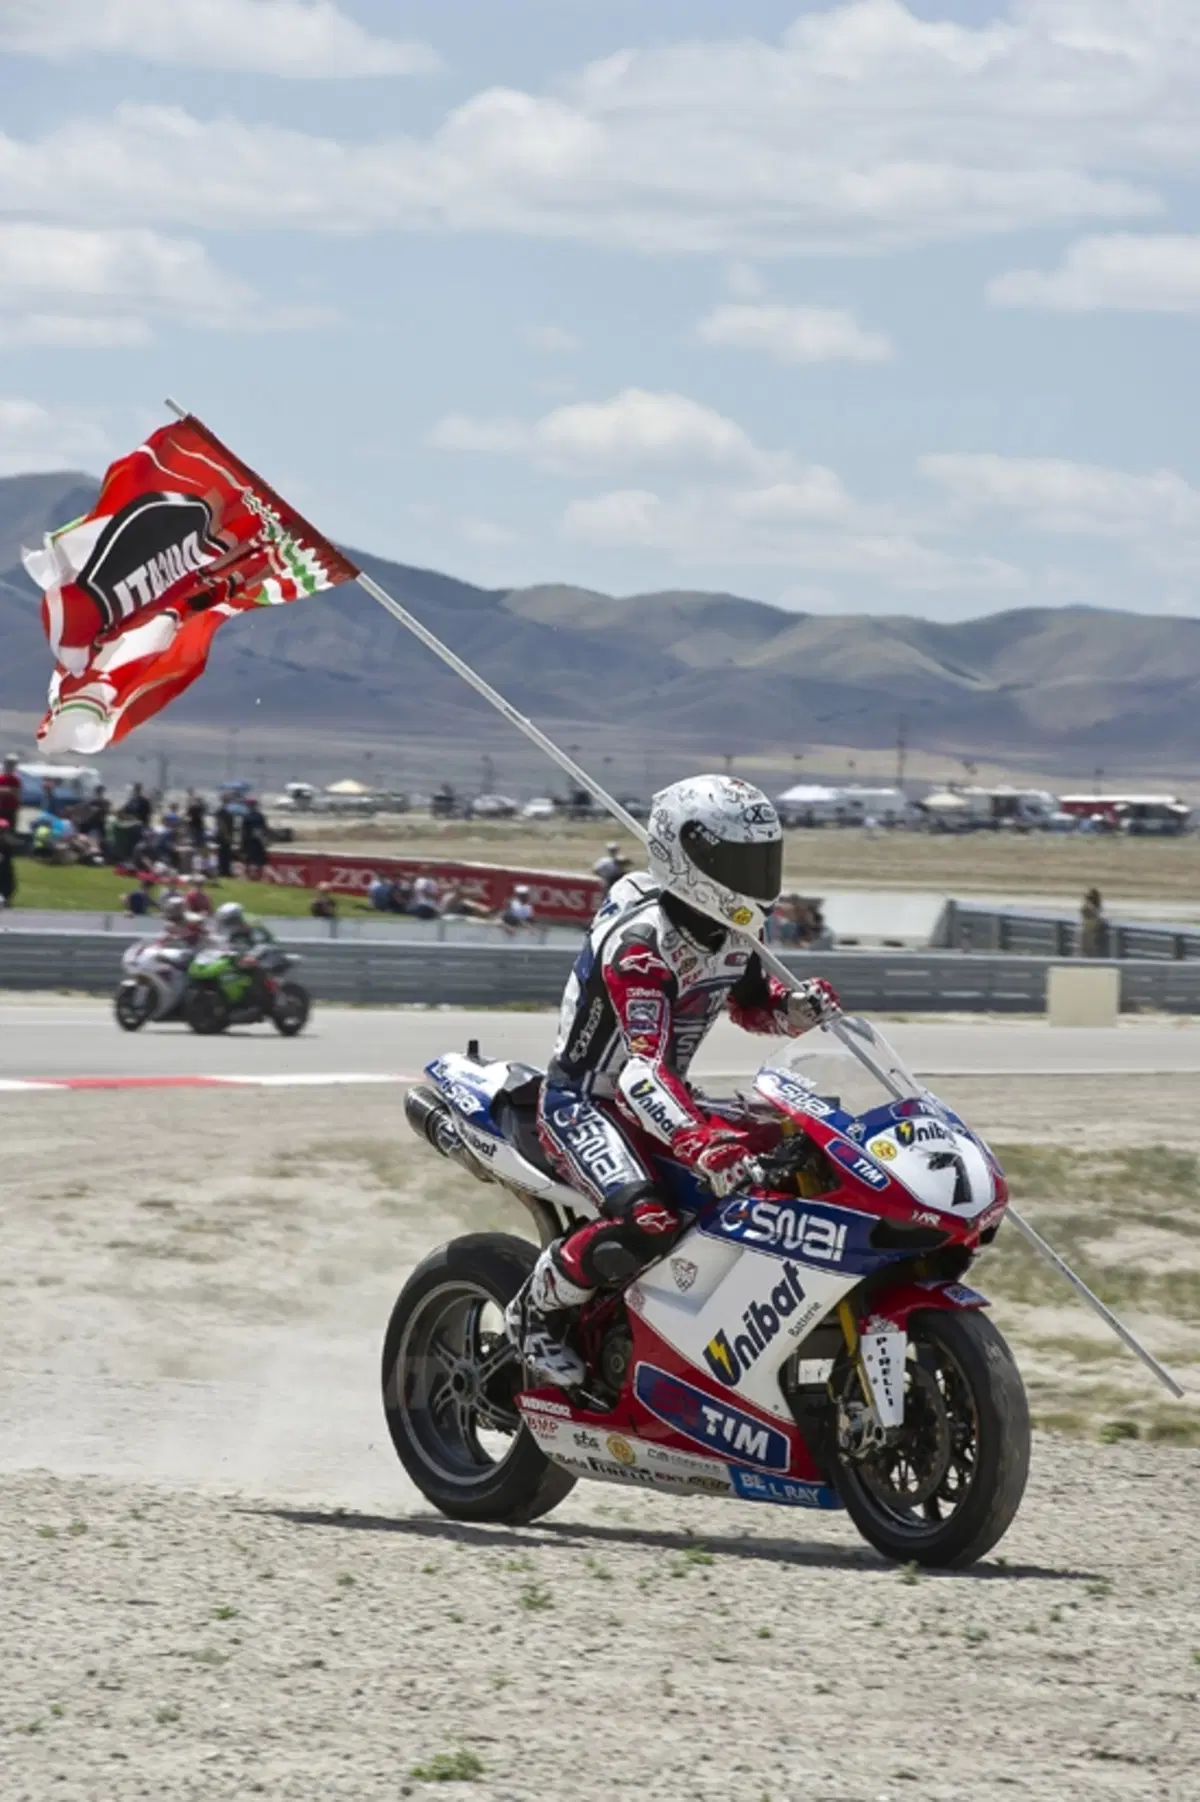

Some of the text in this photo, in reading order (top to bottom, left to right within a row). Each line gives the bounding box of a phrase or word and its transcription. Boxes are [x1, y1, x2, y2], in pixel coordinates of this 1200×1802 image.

[894, 1119, 950, 1148] Unib
[852, 1157, 885, 1184] TIM
[926, 1151, 974, 1207] 7
[702, 1260, 807, 1386] Unibat
[701, 1404, 770, 1462] TIM
